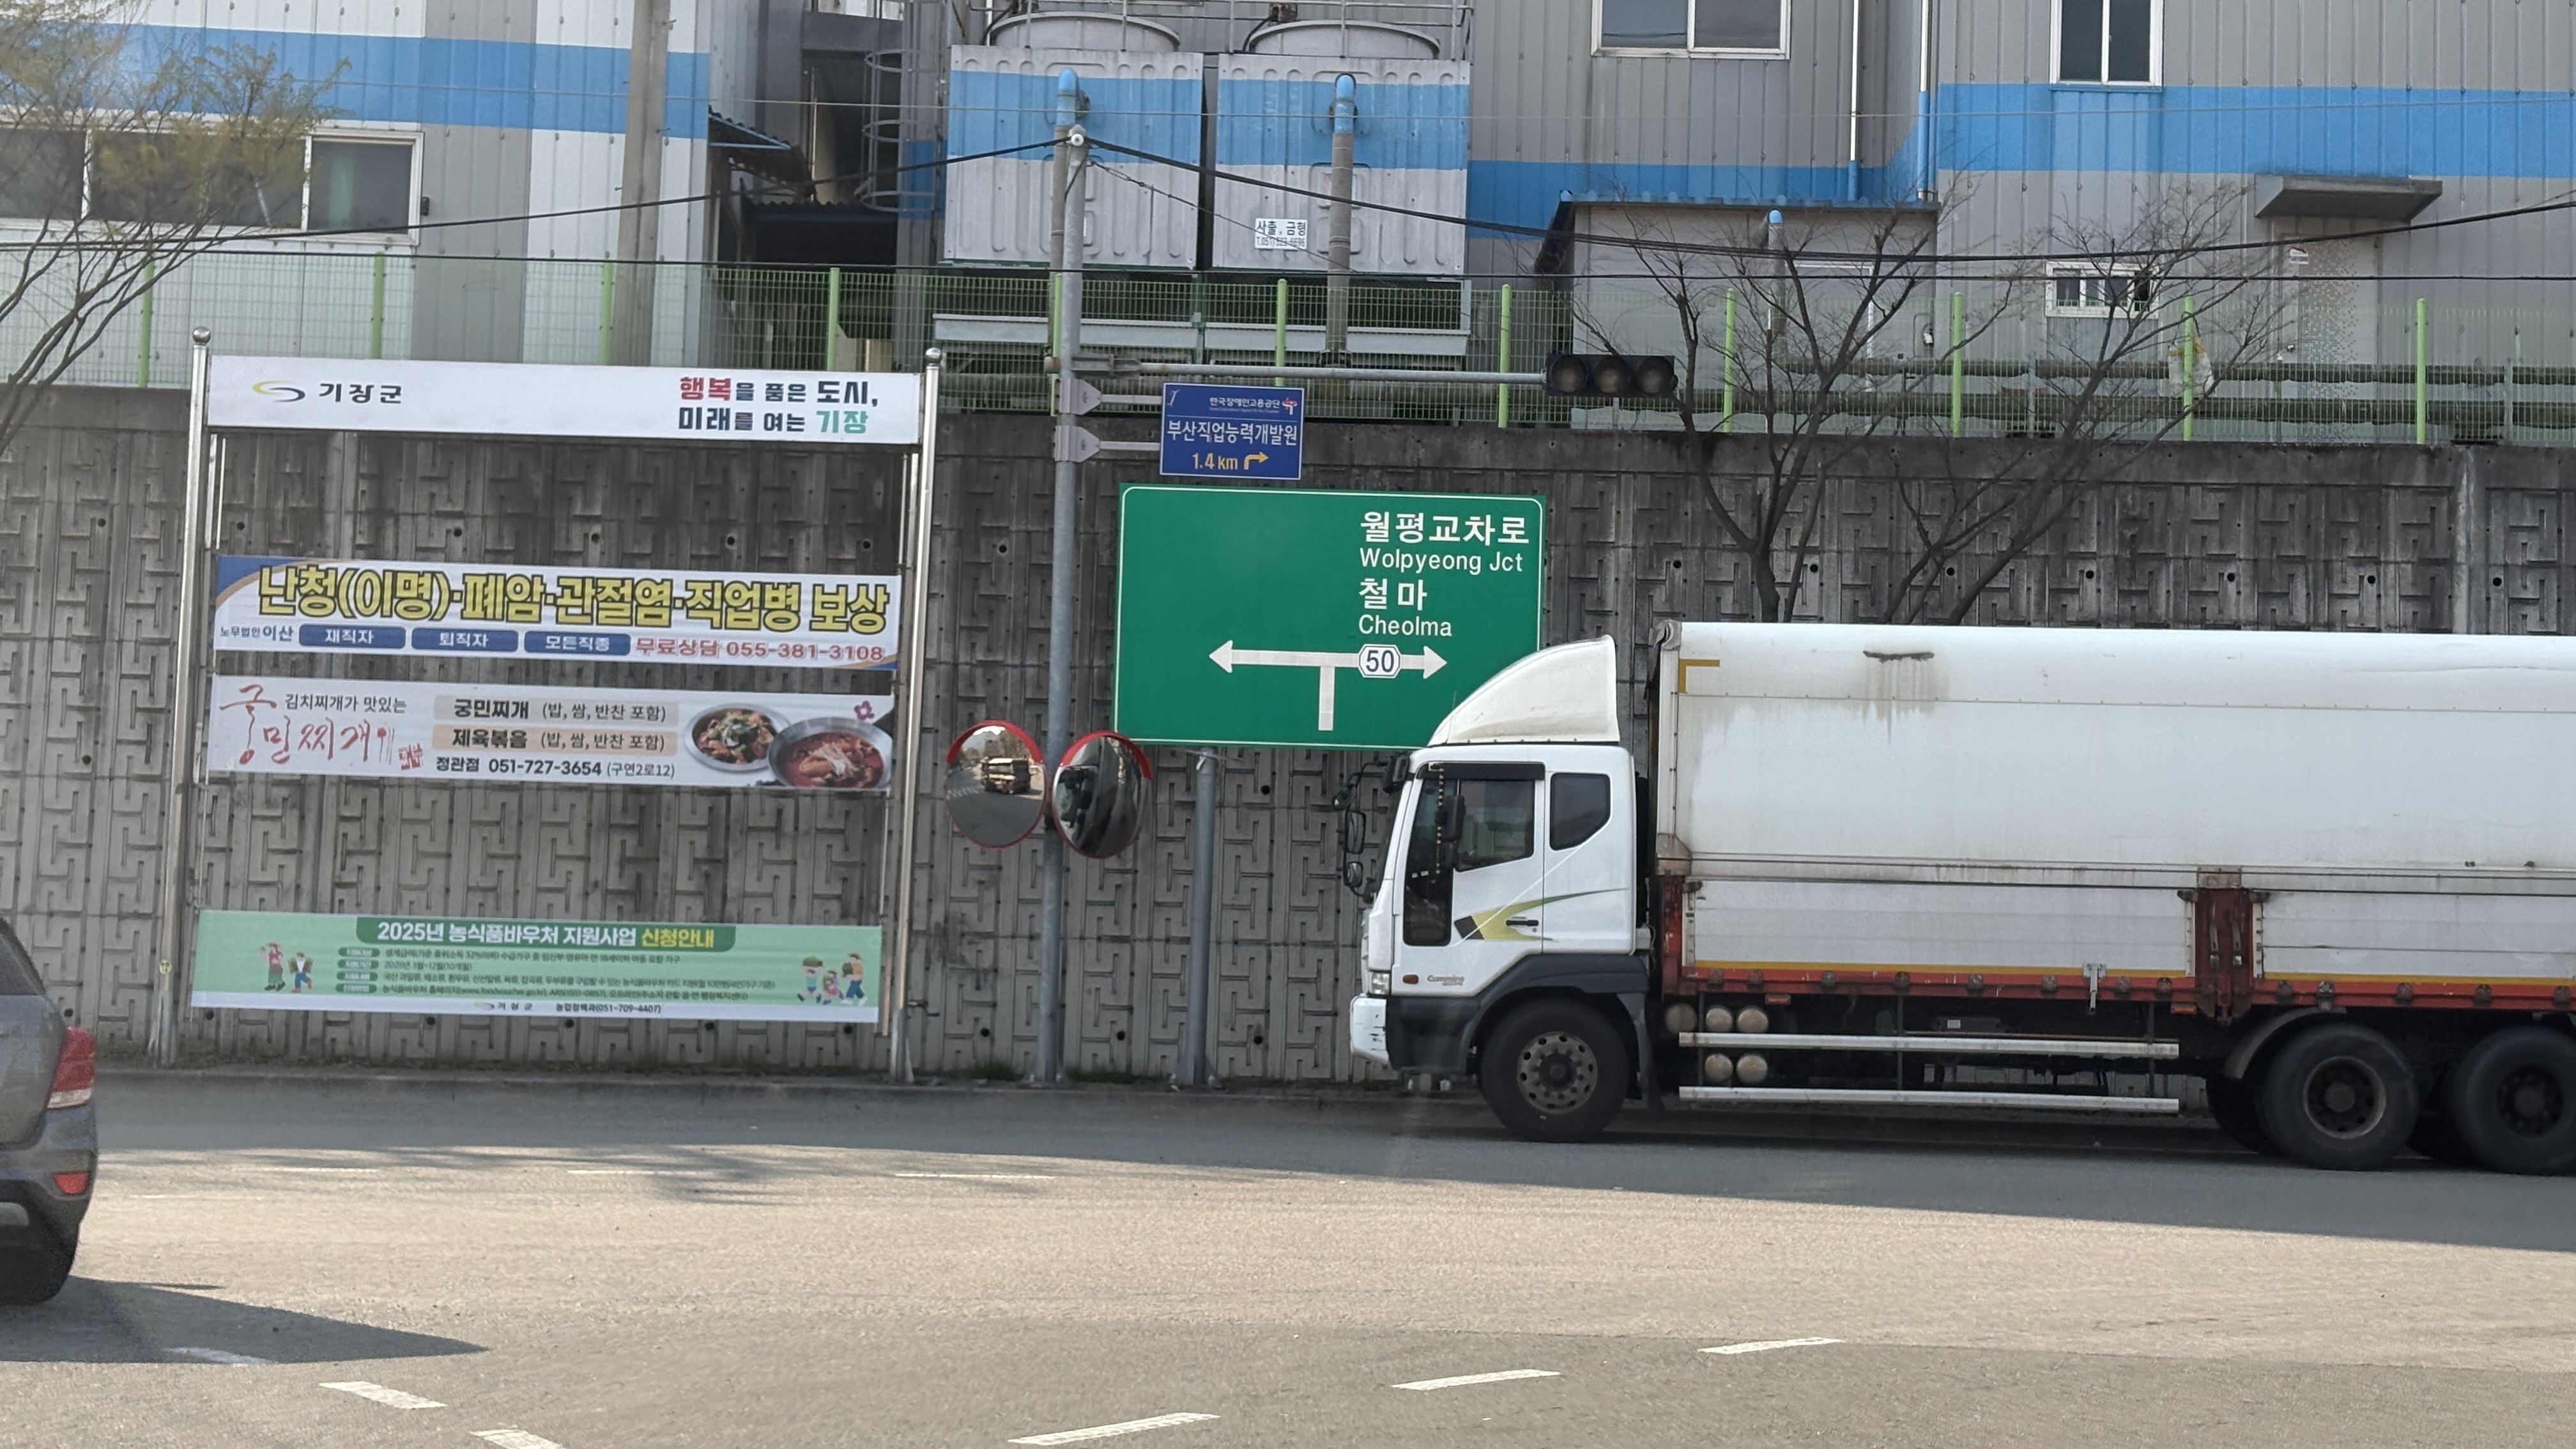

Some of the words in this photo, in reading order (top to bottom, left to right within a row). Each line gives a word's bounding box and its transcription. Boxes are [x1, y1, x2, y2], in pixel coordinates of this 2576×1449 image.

[1286, 221, 1305, 236] 금형
[319, 383, 401, 404] 기장군
[680, 377, 755, 401] 행복을
[765, 383, 806, 402] 품은
[817, 381, 878, 407] 도시,
[678, 407, 753, 431] 미래를
[763, 413, 805, 433] 여는
[816, 410, 869, 434] 기장
[1167, 420, 1298, 446] 부산직업능력개발원
[1192, 451, 1215, 470] 1.4
[1218, 455, 1238, 470] km
[1360, 511, 1529, 546] 월평교차로
[1360, 548, 1482, 575] Wolpyeong
[1489, 551, 1523, 572] Jct
[809, 583, 890, 635] 보상
[325, 629, 374, 645] 재직자
[1359, 614, 1453, 637] Cheolma
[439, 632, 489, 647] 퇴직자
[545, 635, 610, 652] 모든직종
[636, 638, 717, 657] 무료상담
[726, 641, 884, 661] 055-381-3108
[1366, 649, 1395, 673] 50
[285, 693, 358, 713] 김치찌개가
[364, 695, 407, 714] 맛있는
[454, 698, 530, 719] 궁민찌개
[595, 704, 625, 721] 반찬
[630, 705, 666, 724] 포함)
[594, 733, 625, 750] 반찬
[629, 735, 665, 753] 포함)
[436, 756, 480, 772] 정관점
[489, 758, 602, 776] 051-727-3654
[377, 922, 444, 942] 2025년
[449, 923, 559, 945] 농식품바우처
[563, 926, 637, 947] 지원사업
[641, 928, 715, 949] 신청안내
